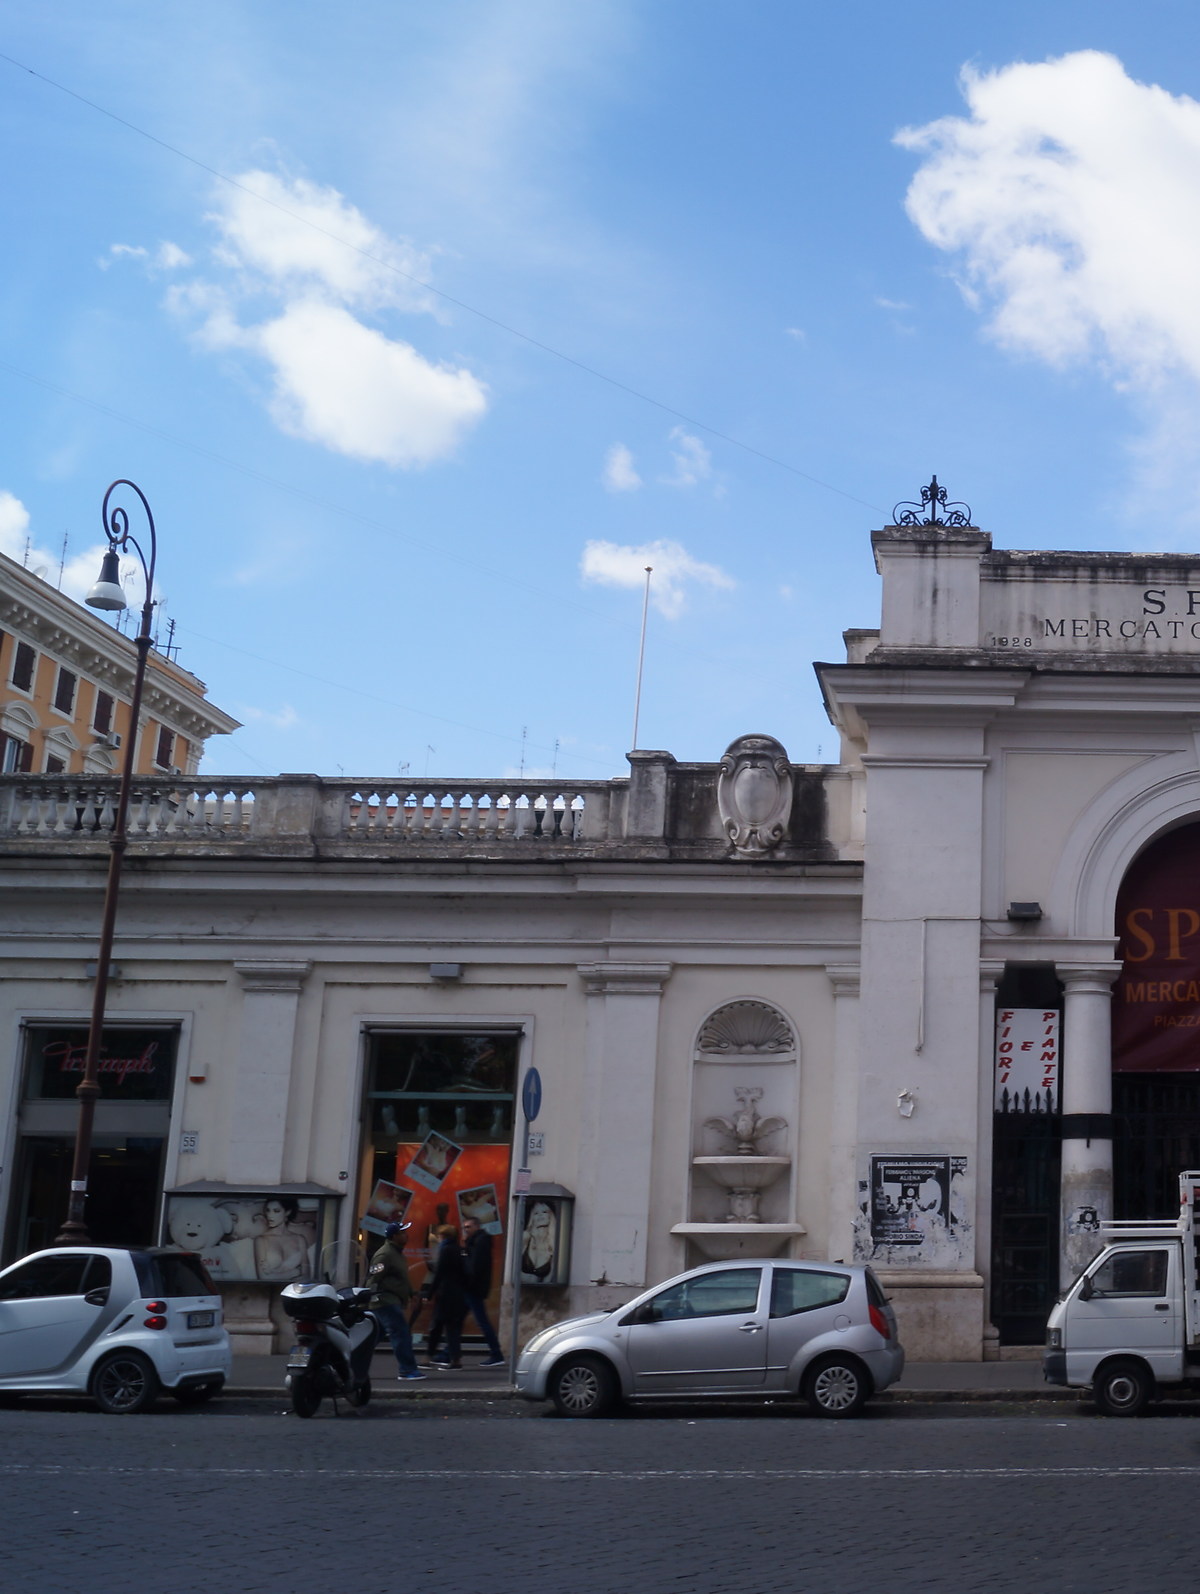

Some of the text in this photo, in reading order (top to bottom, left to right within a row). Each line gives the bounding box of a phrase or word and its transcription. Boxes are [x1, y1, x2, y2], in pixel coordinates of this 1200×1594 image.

[991, 637, 1033, 648] 1928
[998, 1011, 1015, 1084] FIORI
[1020, 1041, 1035, 1052] E
[1040, 1011, 1057, 1088] PIANTE
[41, 1041, 159, 1086] Trimph
[183, 1136, 196, 1147] 55
[529, 1138, 542, 1149] 54
